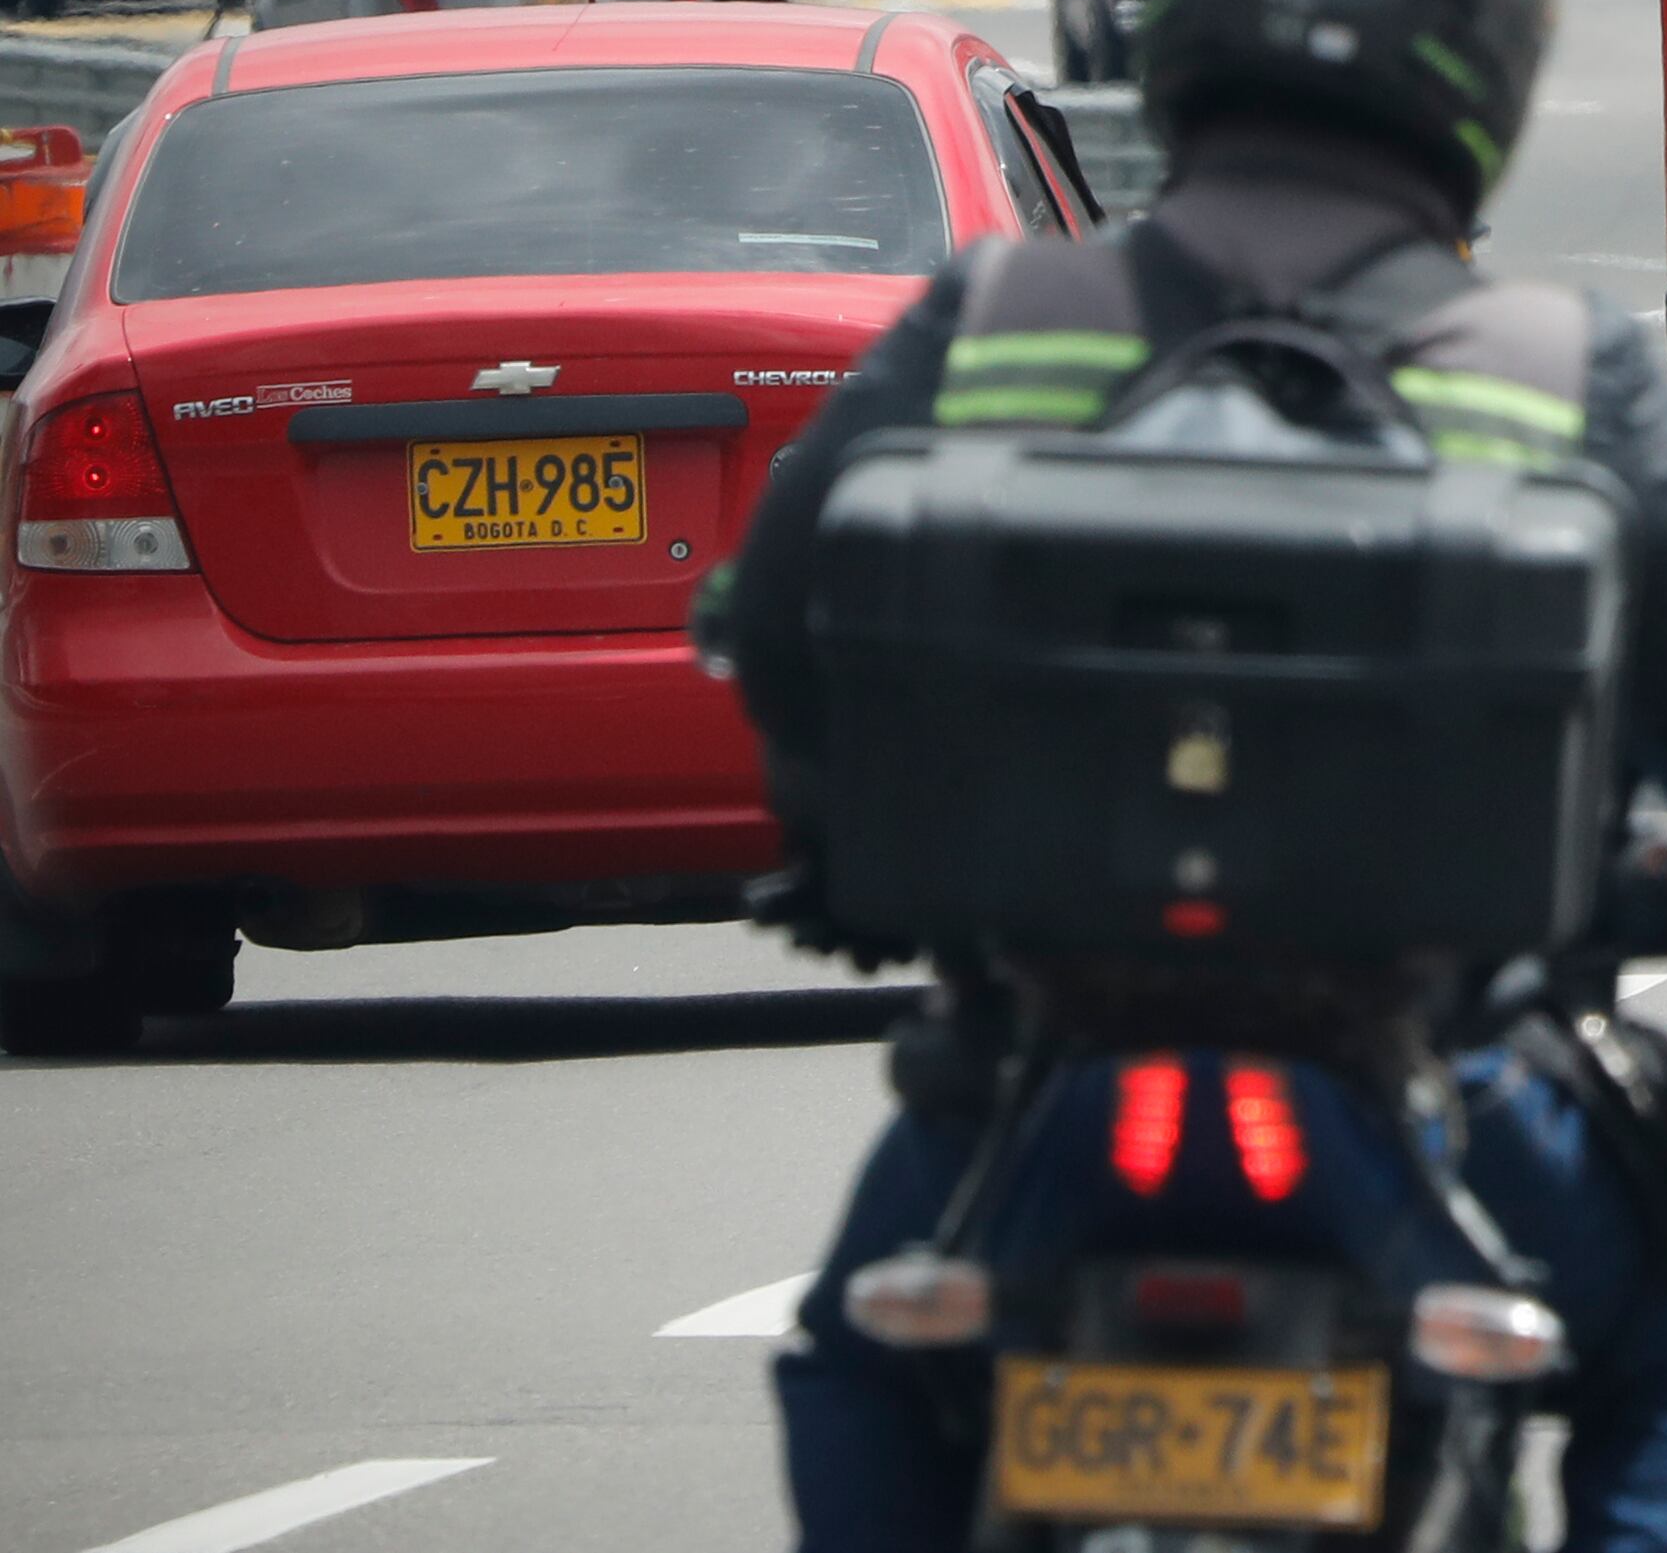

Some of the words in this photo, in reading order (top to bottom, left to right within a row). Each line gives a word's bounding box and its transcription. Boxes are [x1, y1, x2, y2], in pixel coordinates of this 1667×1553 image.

[172, 395, 255, 421] AVEO
[289, 383, 353, 402] Coches
[464, 520, 538, 540] BOGOTA
